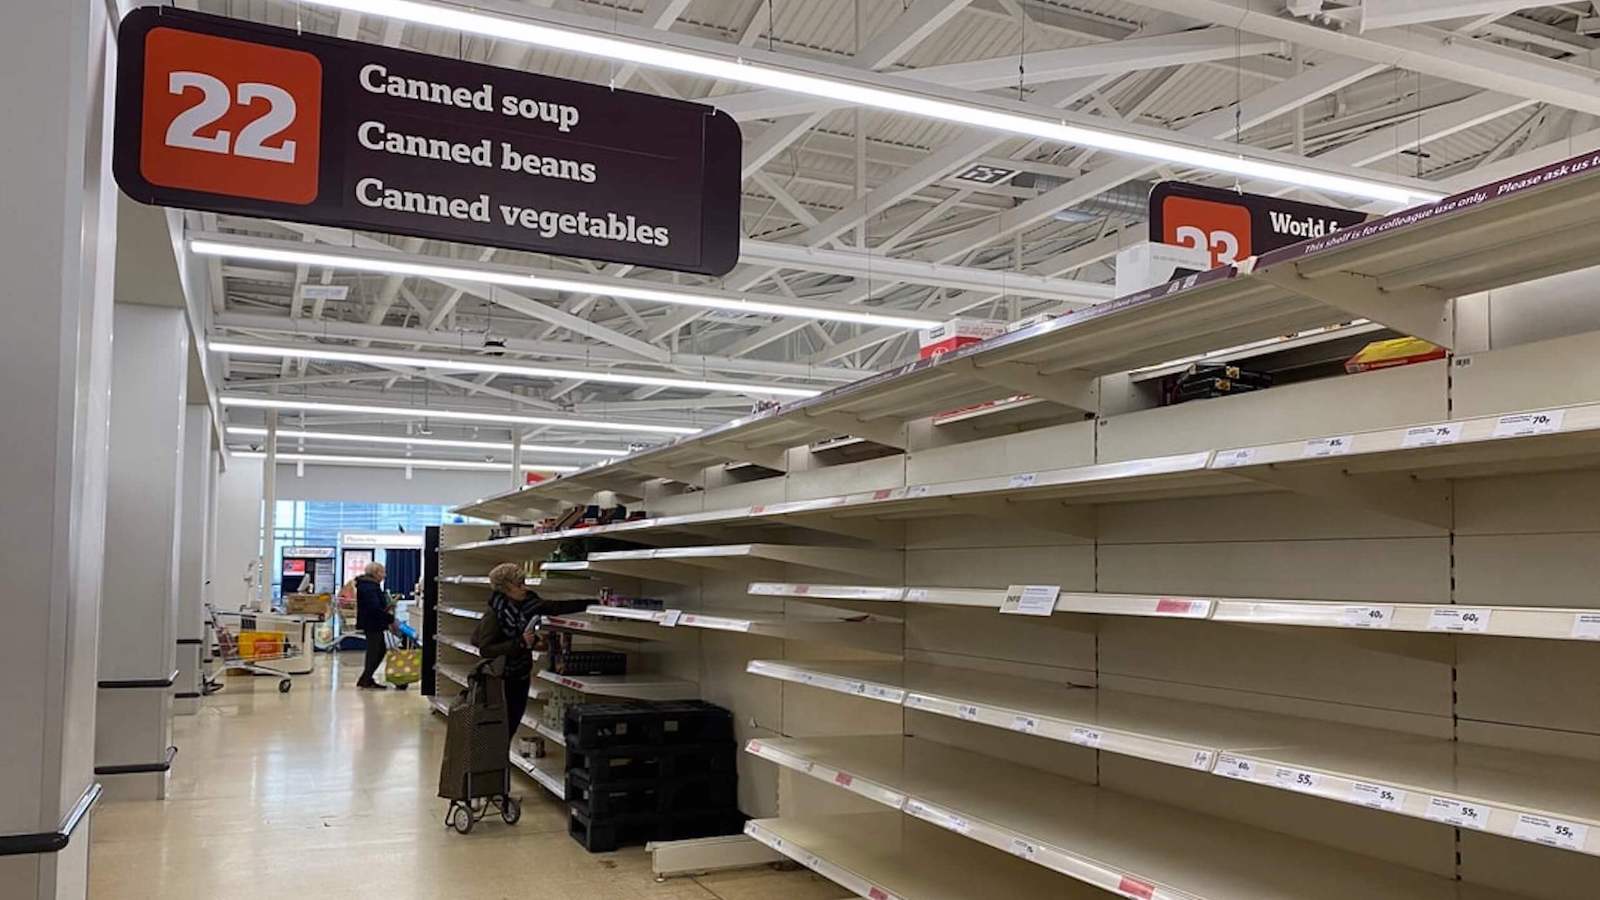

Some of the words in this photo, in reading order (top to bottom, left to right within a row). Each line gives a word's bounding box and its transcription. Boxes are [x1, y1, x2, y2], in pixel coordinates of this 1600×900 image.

[165, 70, 298, 164] 22
[359, 64, 493, 112] Canned
[502, 94, 580, 132] soup
[357, 121, 492, 167] Canned
[502, 143, 597, 184] beans
[356, 178, 490, 223] Canned
[501, 202, 669, 248] vegetables
[1362, 226, 1377, 237] for
[1379, 209, 1433, 231] colleague
[1435, 202, 1457, 214] use
[1497, 175, 1542, 195] Please
[1543, 165, 1570, 181] ask
[1571, 160, 1589, 172] us
[1269, 211, 1325, 238] World
[1462, 613, 1479, 623] 60p
[1297, 773, 1312, 786] 55p
[1461, 806, 1478, 819] 55p
[1554, 824, 1574, 838] 55p
